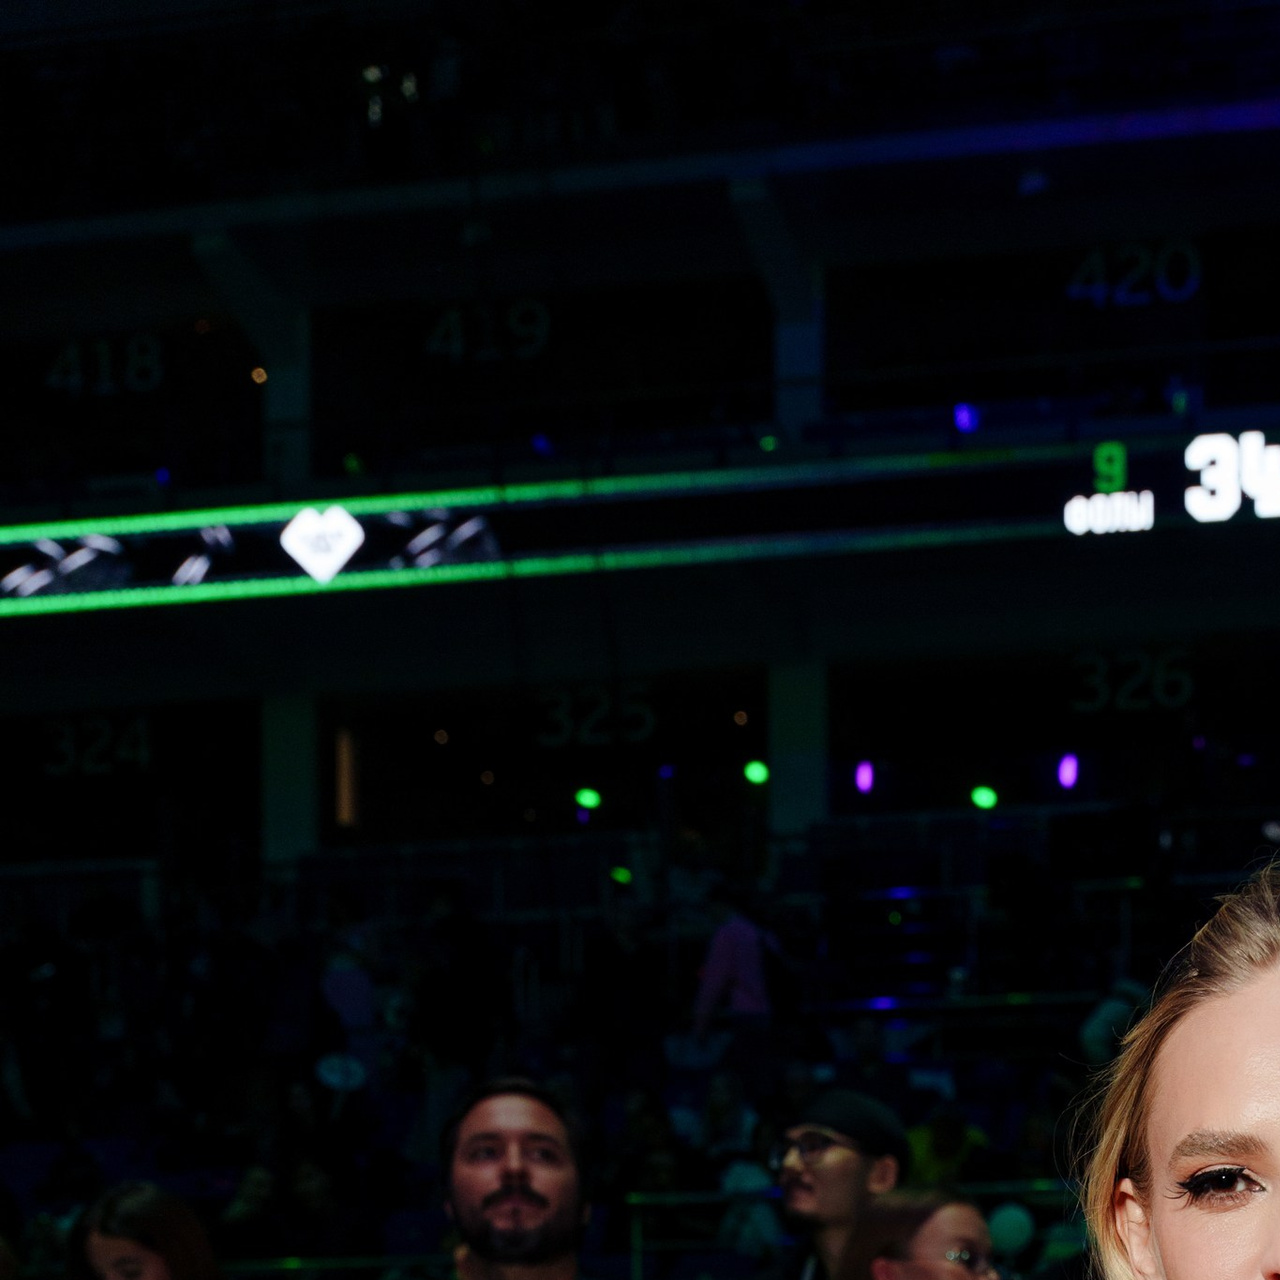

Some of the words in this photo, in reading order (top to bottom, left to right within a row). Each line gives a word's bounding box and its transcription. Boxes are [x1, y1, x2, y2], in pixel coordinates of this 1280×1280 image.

[1064, 239, 1203, 309] 420
[424, 299, 552, 367] 419
[44, 334, 167, 402] 418
[1093, 441, 1128, 493] 9
[1069, 645, 1195, 715] 326
[42, 714, 156, 778] 324
[534, 686, 658, 749] 325
